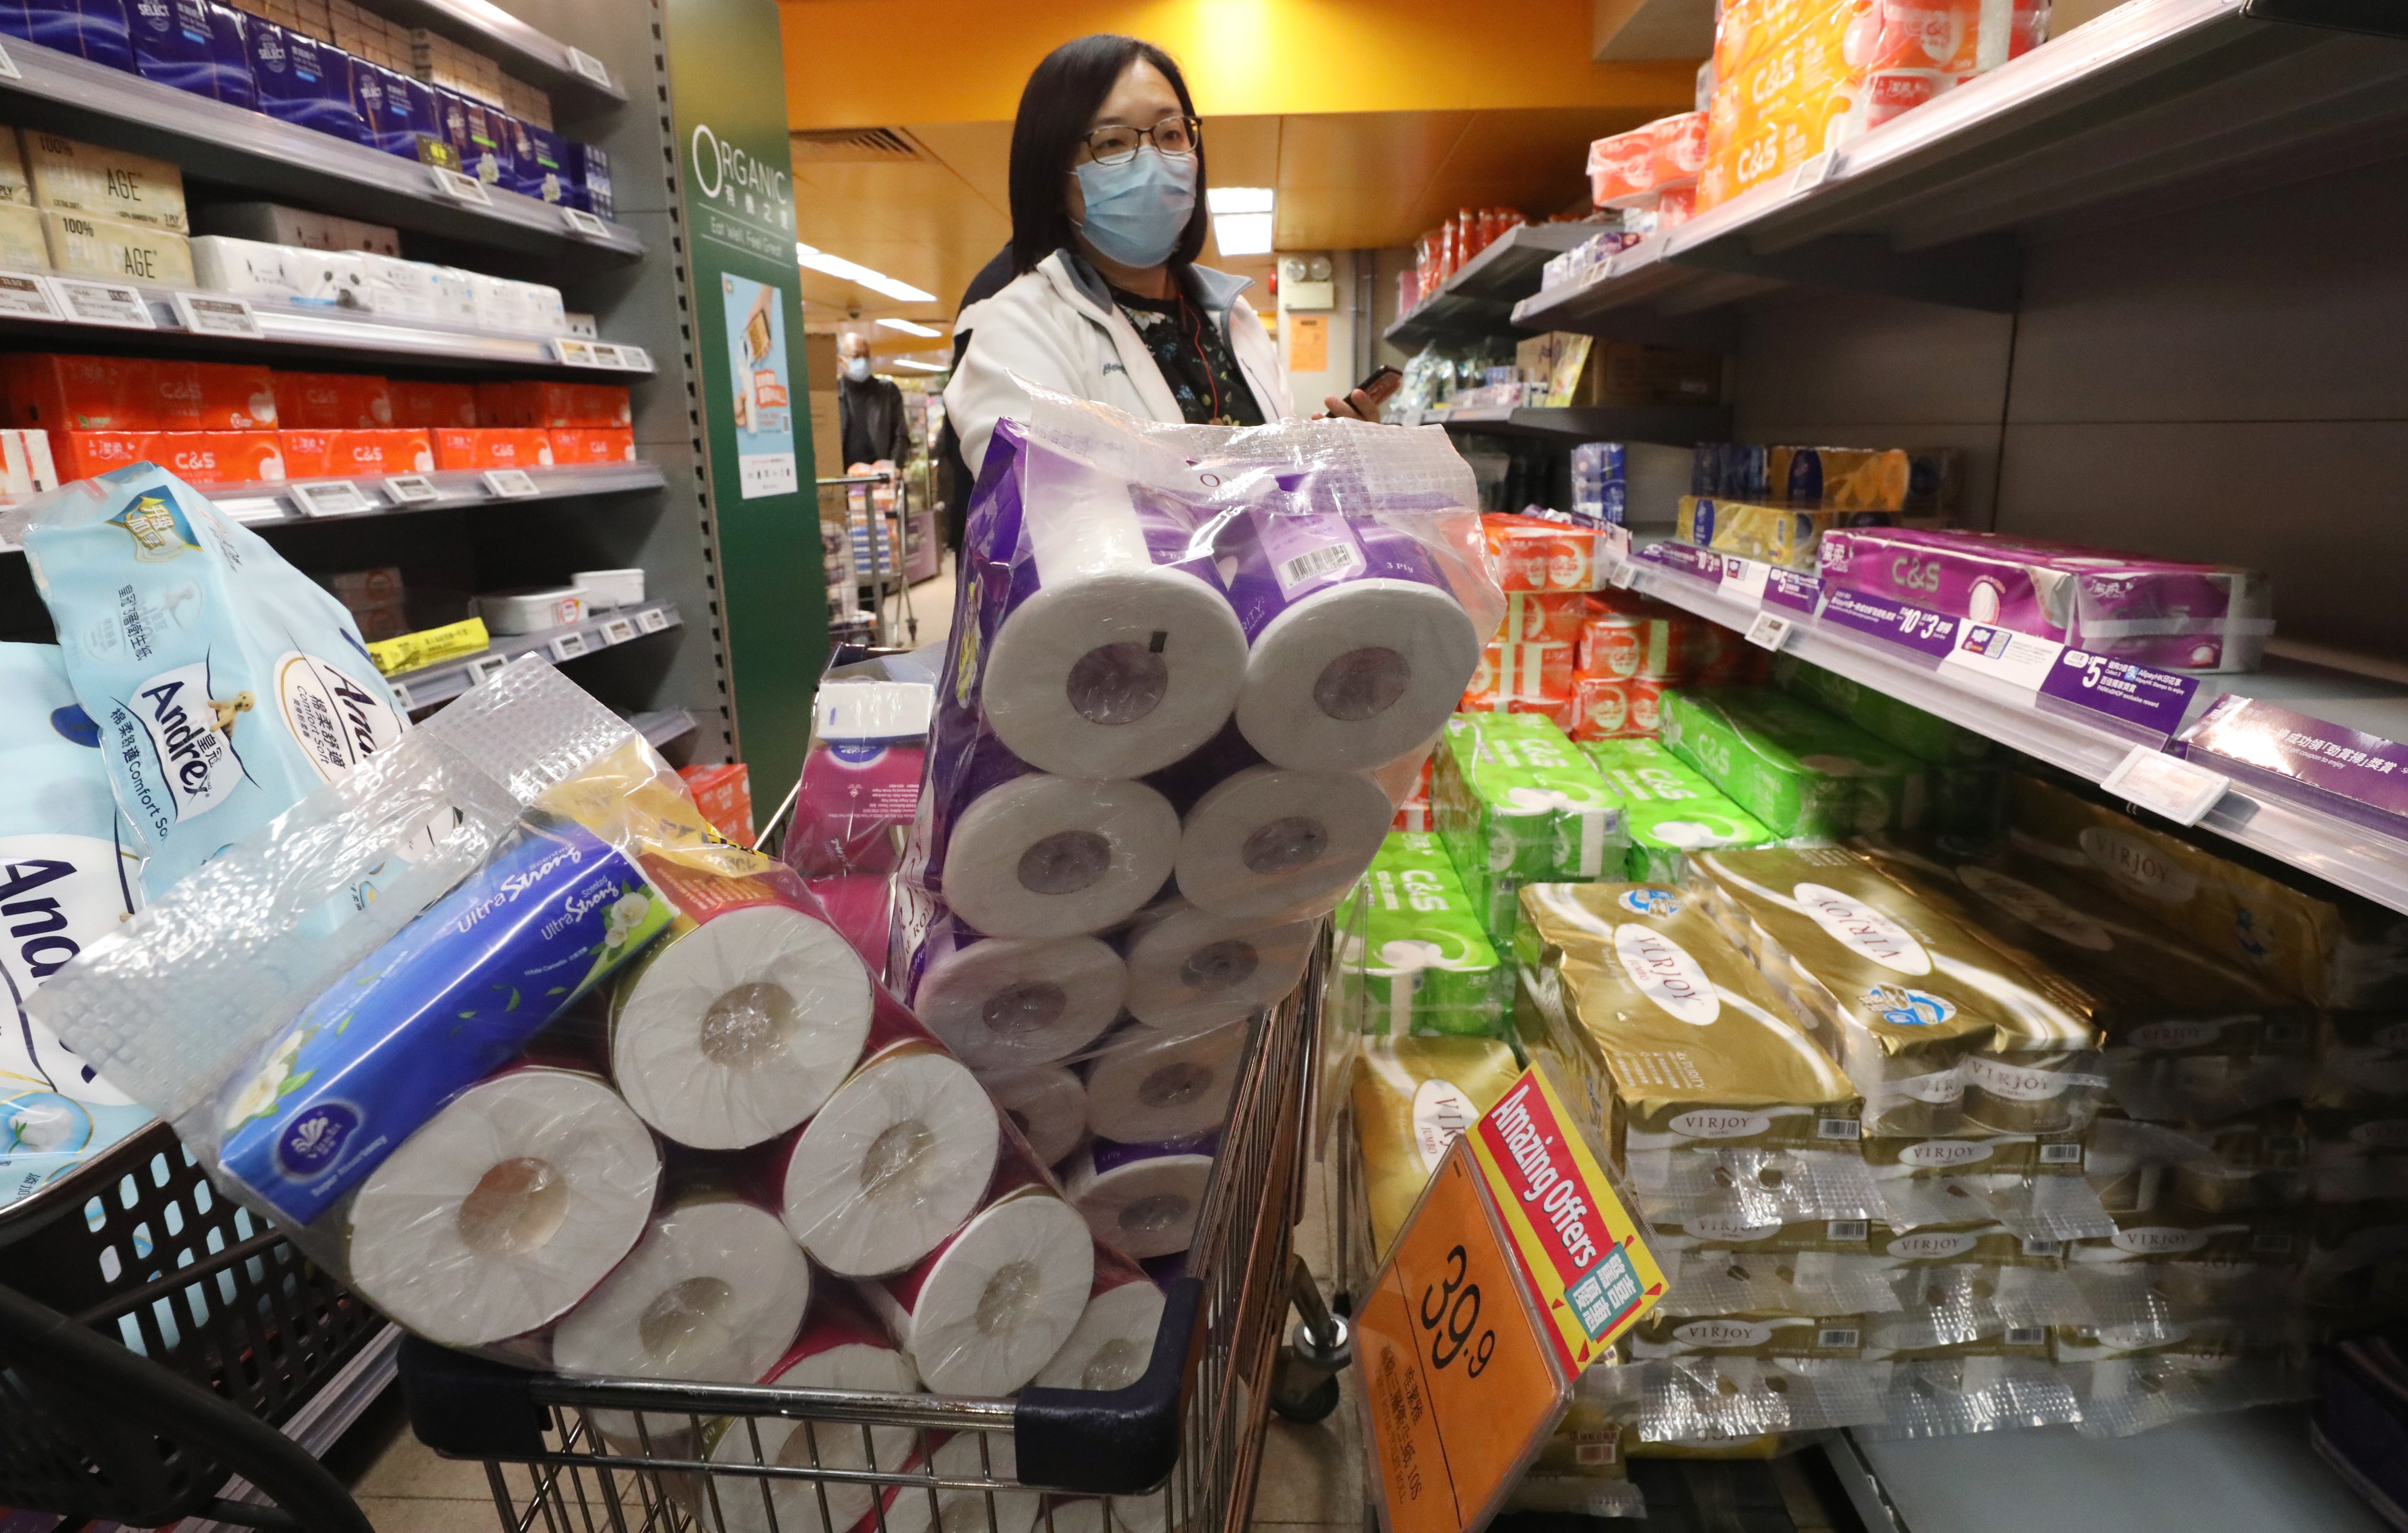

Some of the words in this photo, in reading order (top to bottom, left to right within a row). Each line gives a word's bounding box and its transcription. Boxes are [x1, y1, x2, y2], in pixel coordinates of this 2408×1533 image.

[138, 4, 170, 17] SELECT
[1752, 48, 1795, 104] C&S
[40, 137, 73, 157] 100%
[1737, 132, 1777, 184] C&S
[692, 124, 787, 205] ORGANIC
[63, 218, 94, 237] 100%
[175, 452, 215, 470] C&S
[353, 446, 382, 461] C&S
[1387, 562, 1393, 570] 3
[1396, 562, 1414, 573] Ply
[1891, 556, 1941, 594] C&S
[1899, 608, 1922, 633] 10
[1920, 615, 1939, 639] 3
[2143, 698, 2160, 708] reward
[2173, 686, 2185, 695] enjoy
[297, 685, 320, 735] Comfort
[314, 737, 330, 765] Soft
[141, 681, 209, 806] Andrex
[2299, 749, 2321, 762] coupon
[2327, 759, 2346, 770] enjoy
[129, 761, 161, 818] Comfort
[458, 893, 506, 934] Ultra
[500, 845, 582, 902] Strong
[582, 875, 609, 898] Scented
[1400, 869, 1450, 912] C&S
[541, 914, 575, 942] Ultra
[565, 882, 620, 922] Strong
[1814, 896, 1904, 959] VIRJOY
[1628, 959, 1651, 982] JUMBO
[1635, 935, 1703, 1007] VIRJOY
[1971, 1059, 2050, 1090] VIRJOY
[1685, 1116, 1751, 1130] VIRJOY
[1421, 1125, 1438, 1154] JUMBO
[1913, 1146, 1976, 1159] VIRJOY
[1491, 1084, 1551, 1203] Amazing
[1542, 1179, 1596, 1267] Offers
[1901, 1236, 1961, 1251] VIRJOY
[2127, 1233, 2188, 1246] VIRJOY
[1596, 1252, 1637, 1310] 驚喜
[1421, 1244, 1495, 1378] 39.9
[1572, 1275, 1612, 1334] 優惠
[1688, 1326, 1754, 1340] VIRJOY
